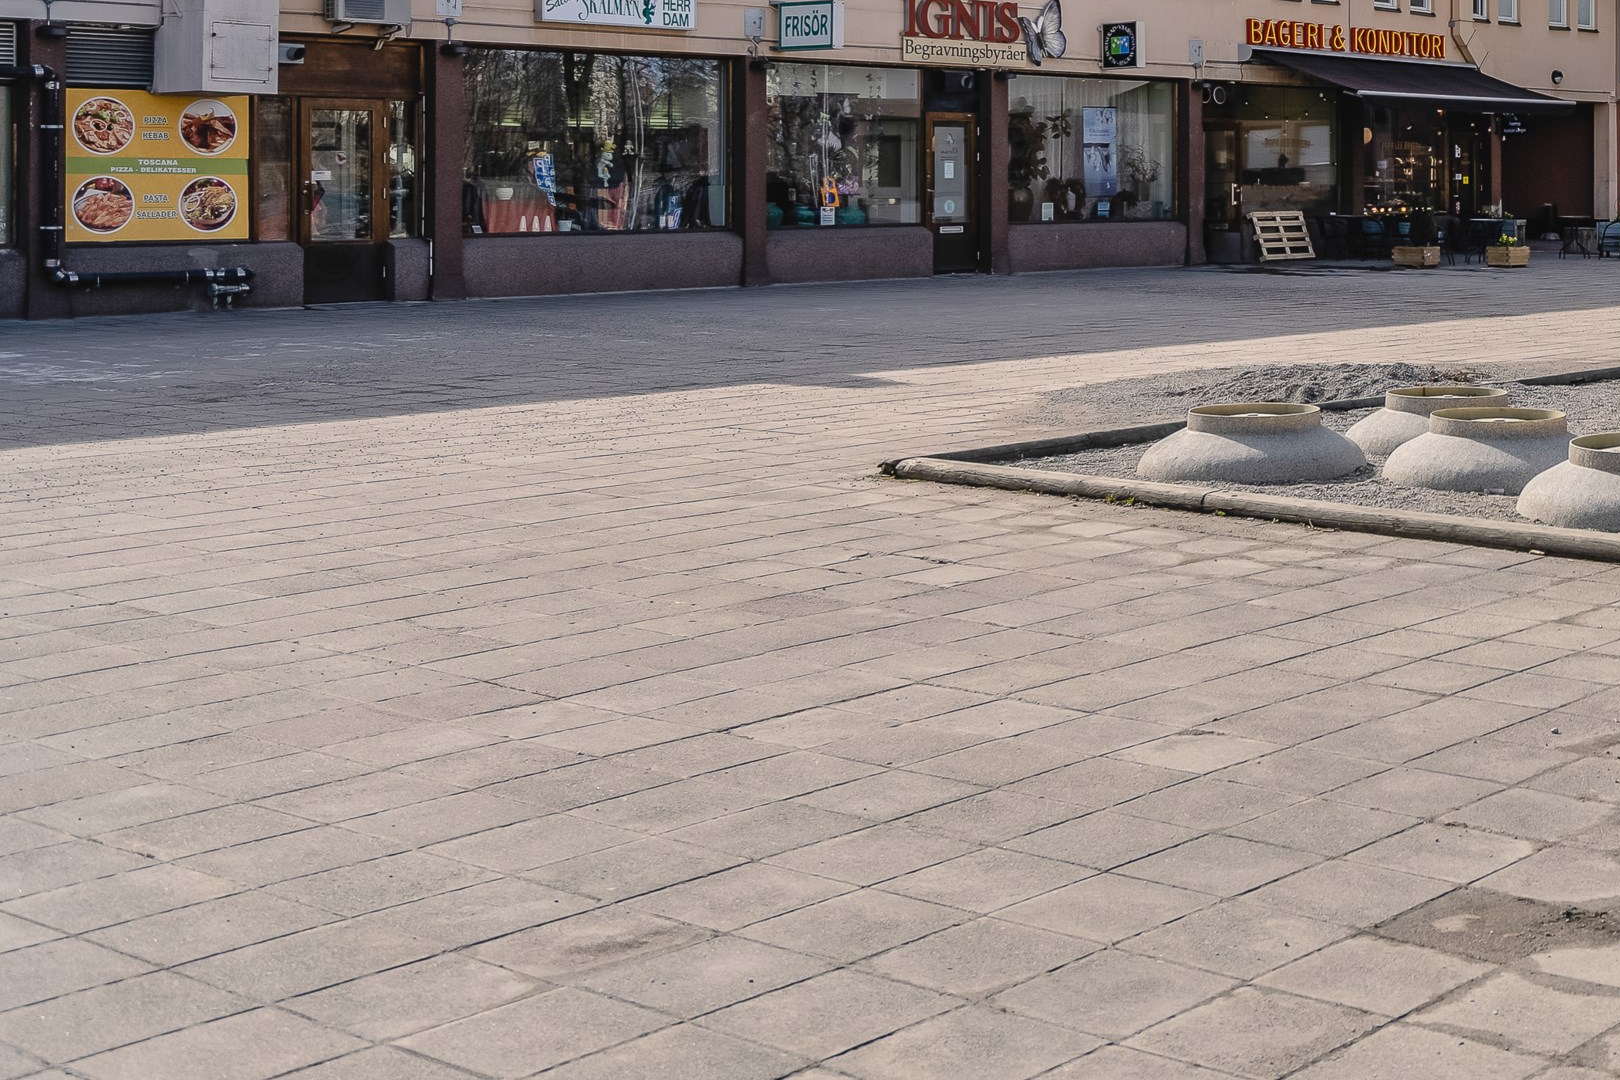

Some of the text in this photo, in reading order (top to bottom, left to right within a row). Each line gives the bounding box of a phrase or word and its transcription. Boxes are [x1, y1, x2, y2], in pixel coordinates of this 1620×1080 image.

[662, 12, 690, 27] DAM
[785, 9, 828, 37] FRISÖR
[1246, 18, 1446, 58] BAGERI & KONDITORI
[904, 39, 1026, 64] Begravningsbyråer
[143, 116, 168, 125] PIZZA
[142, 132, 169, 140] KEBAB
[143, 194, 169, 202] PASTA
[136, 210, 178, 219] SALLADER
